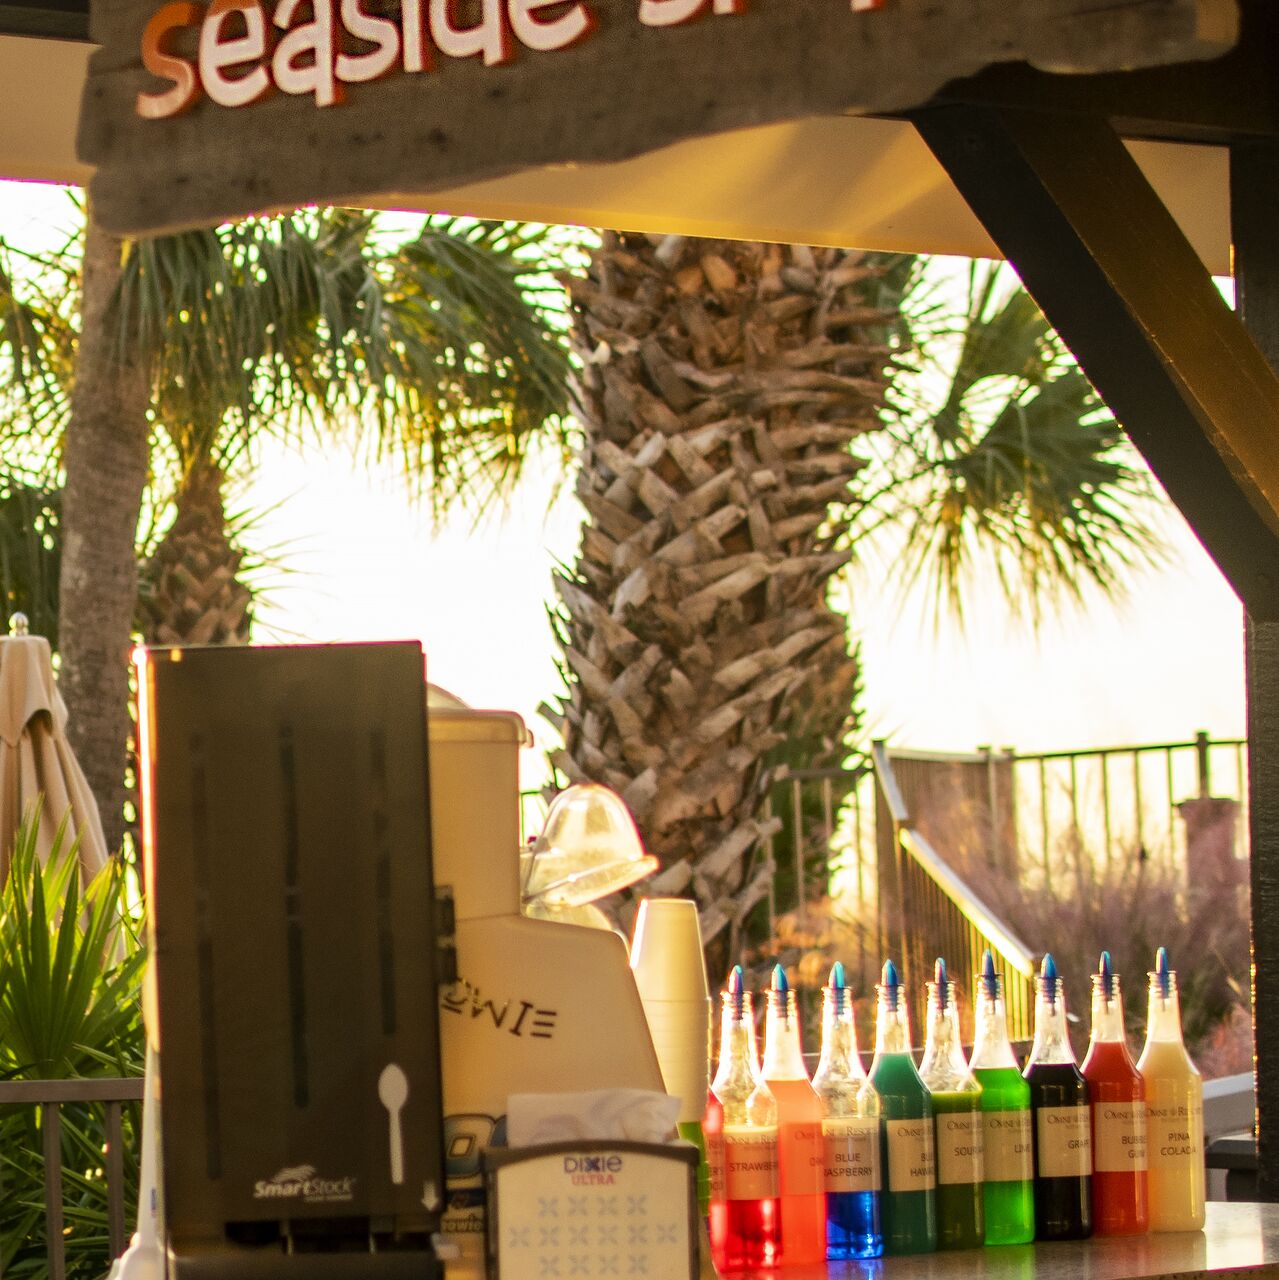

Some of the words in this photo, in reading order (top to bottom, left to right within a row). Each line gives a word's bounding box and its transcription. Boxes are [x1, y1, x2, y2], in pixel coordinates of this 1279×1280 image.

[1168, 1132, 1190, 1142] PINA
[835, 1152, 861, 1163] BLUE
[571, 1174, 616, 1187] ULTRA
